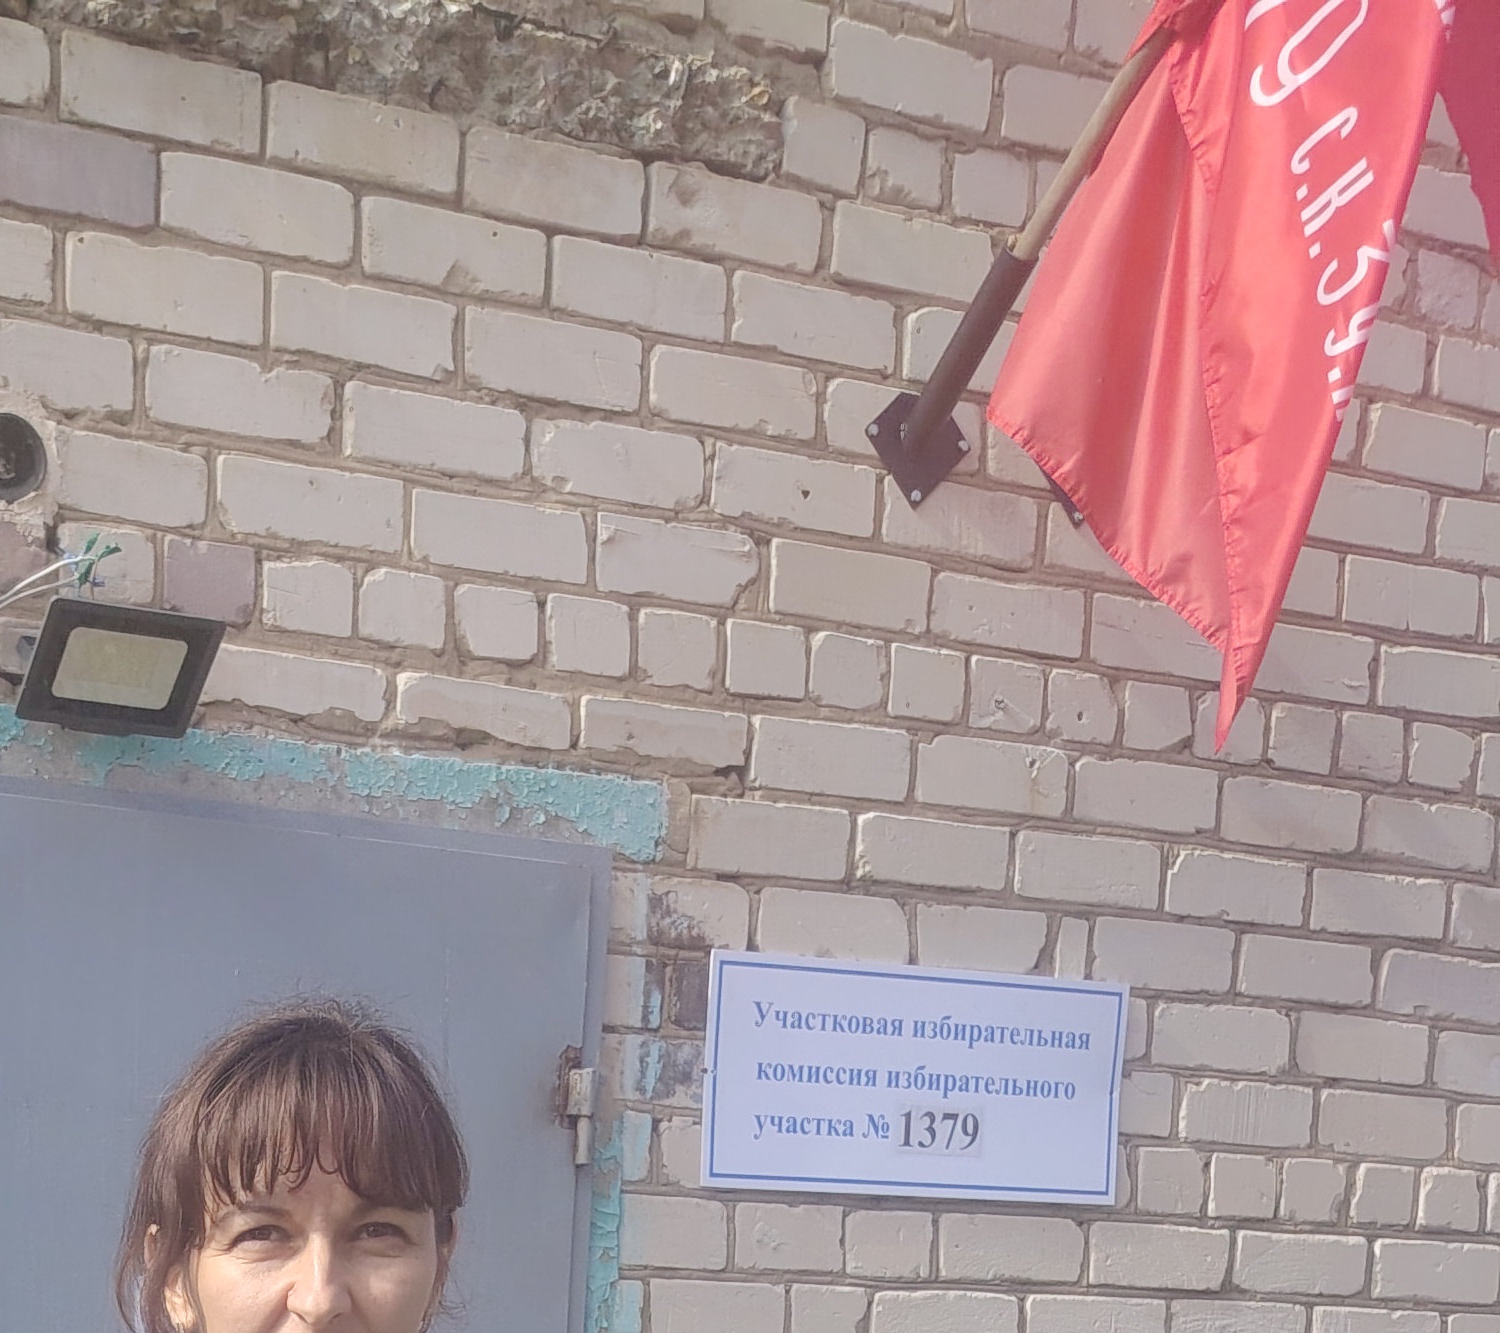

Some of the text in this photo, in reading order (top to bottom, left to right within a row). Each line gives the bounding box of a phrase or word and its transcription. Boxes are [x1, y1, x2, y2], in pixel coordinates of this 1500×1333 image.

[752, 1000, 1091, 1051] Участковая избирательная
[756, 1060, 1077, 1101] комиссия избирательного
[753, 1108, 980, 1151] участка № 1379
